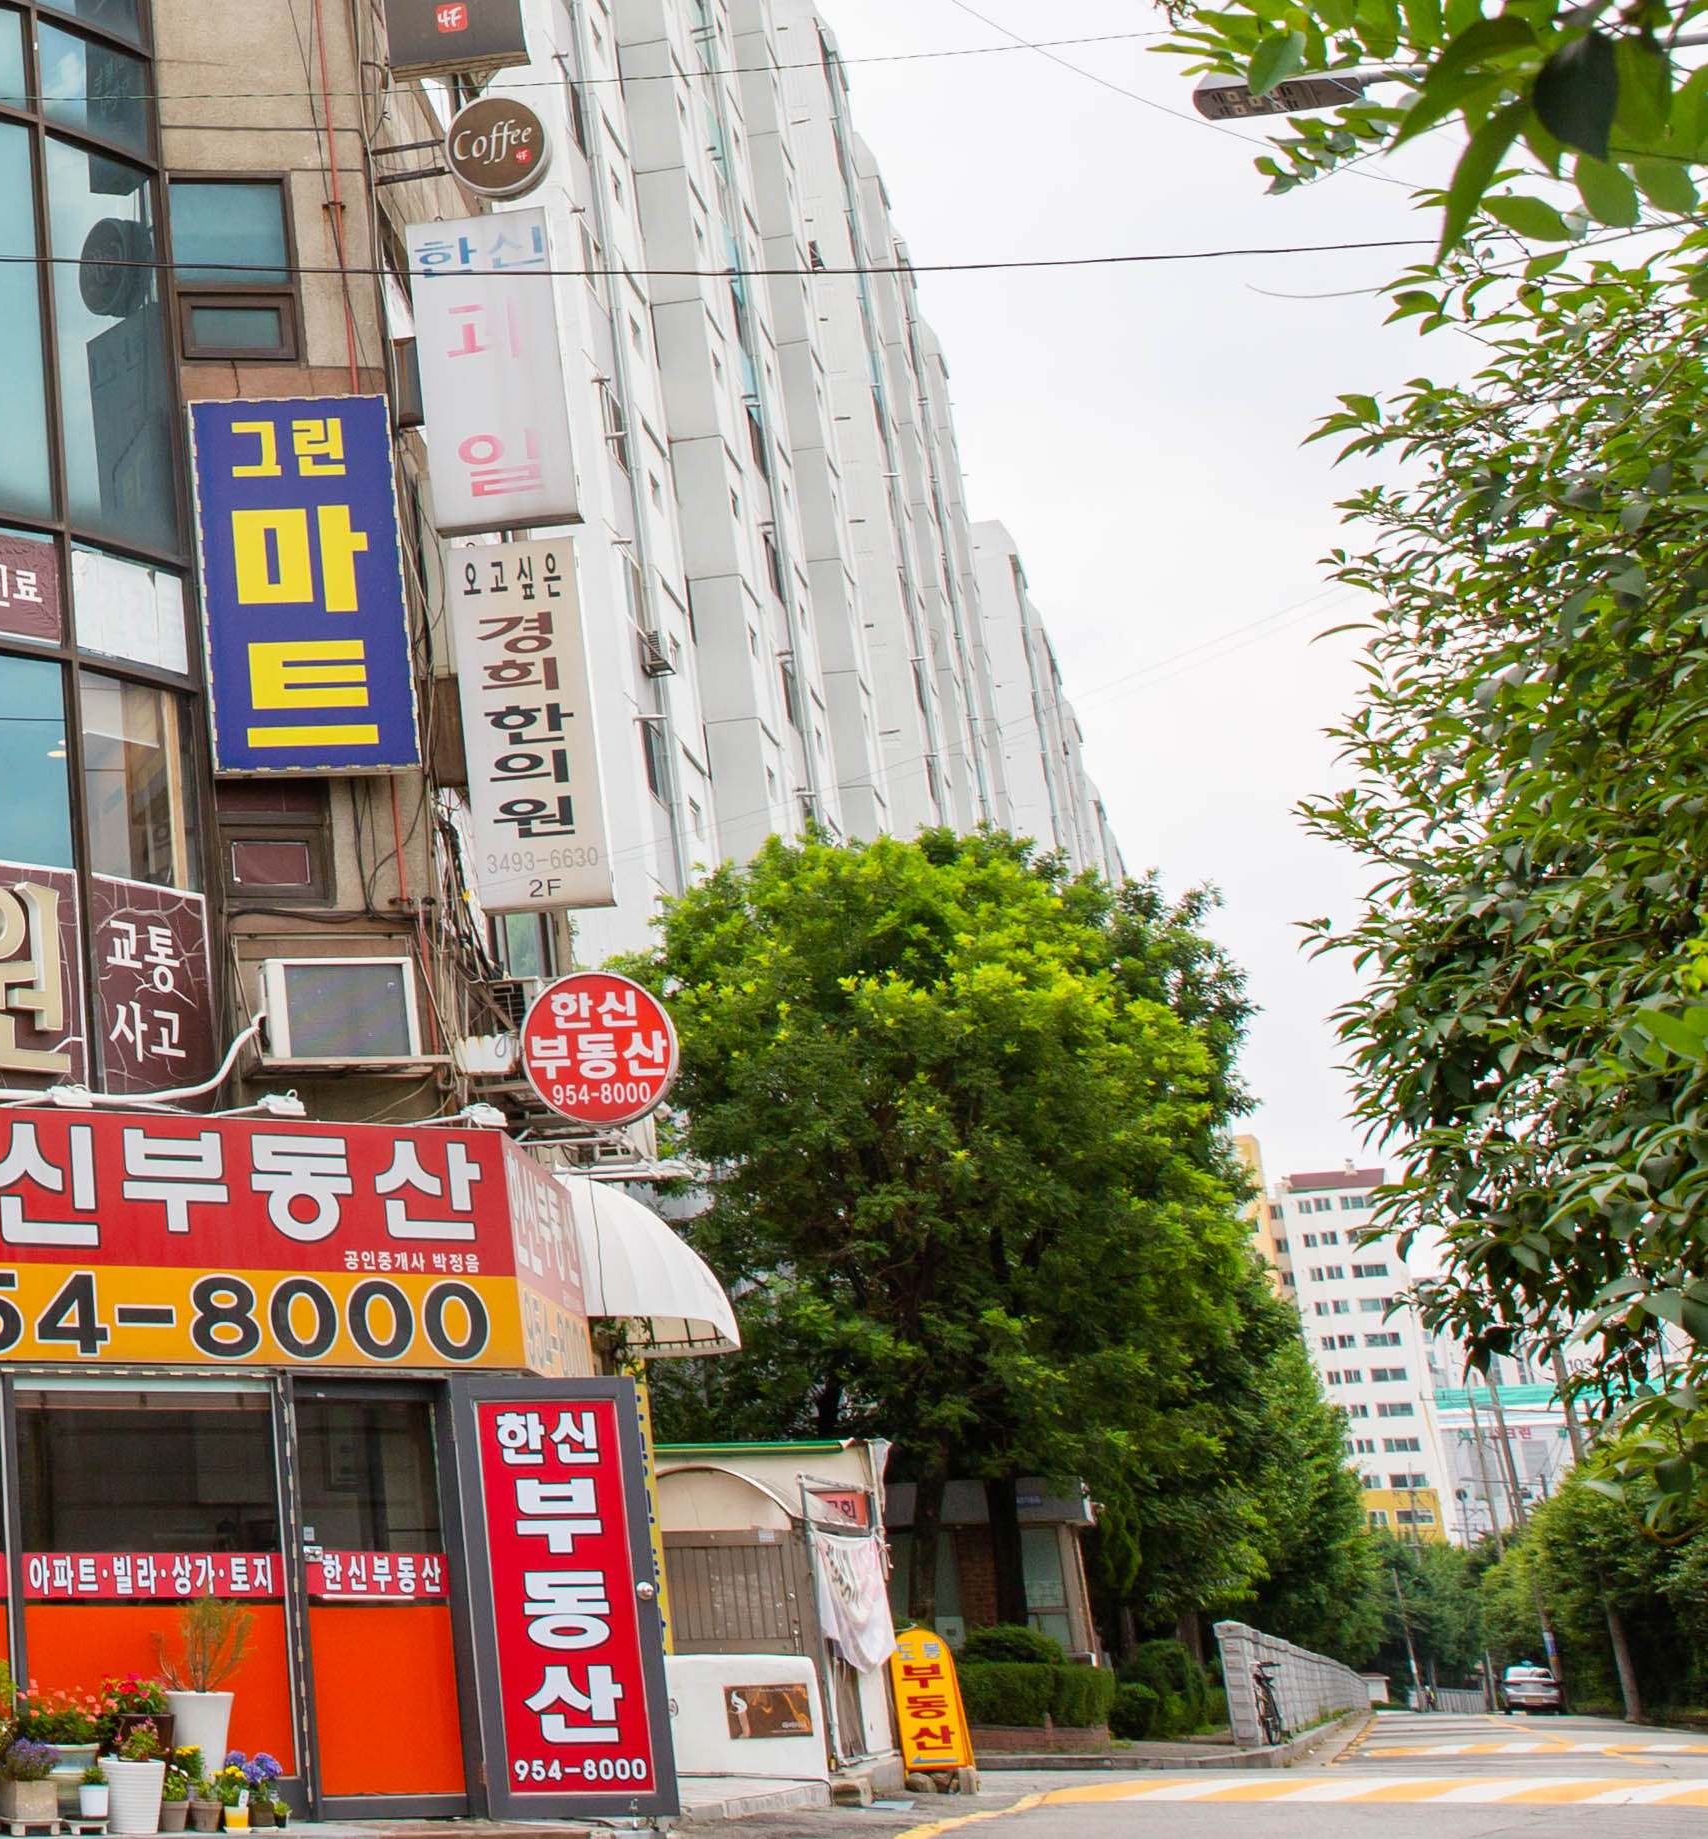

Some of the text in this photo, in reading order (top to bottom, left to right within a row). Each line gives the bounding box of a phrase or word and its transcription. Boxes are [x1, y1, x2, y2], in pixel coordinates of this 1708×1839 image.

[453, 119, 532, 165] Coffee
[231, 418, 347, 478] 그린
[487, 847, 599, 874] 3493-6630
[529, 878, 562, 898] 2F
[106, 918, 183, 994] 교통
[109, 1000, 187, 1063] 사고
[550, 991, 638, 1029] 한신
[530, 1030, 668, 1080] 부동산
[552, 1082, 651, 1106] 954-8000
[344, 1250, 425, 1272] 공인중개사
[495, 1410, 601, 1466] 한신
[321, 1553, 443, 1593] 한신부동산
[515, 1476, 623, 1745] 부동산
[901, 1663, 955, 1752] 부동산
[513, 1757, 648, 1782] 954-8000
